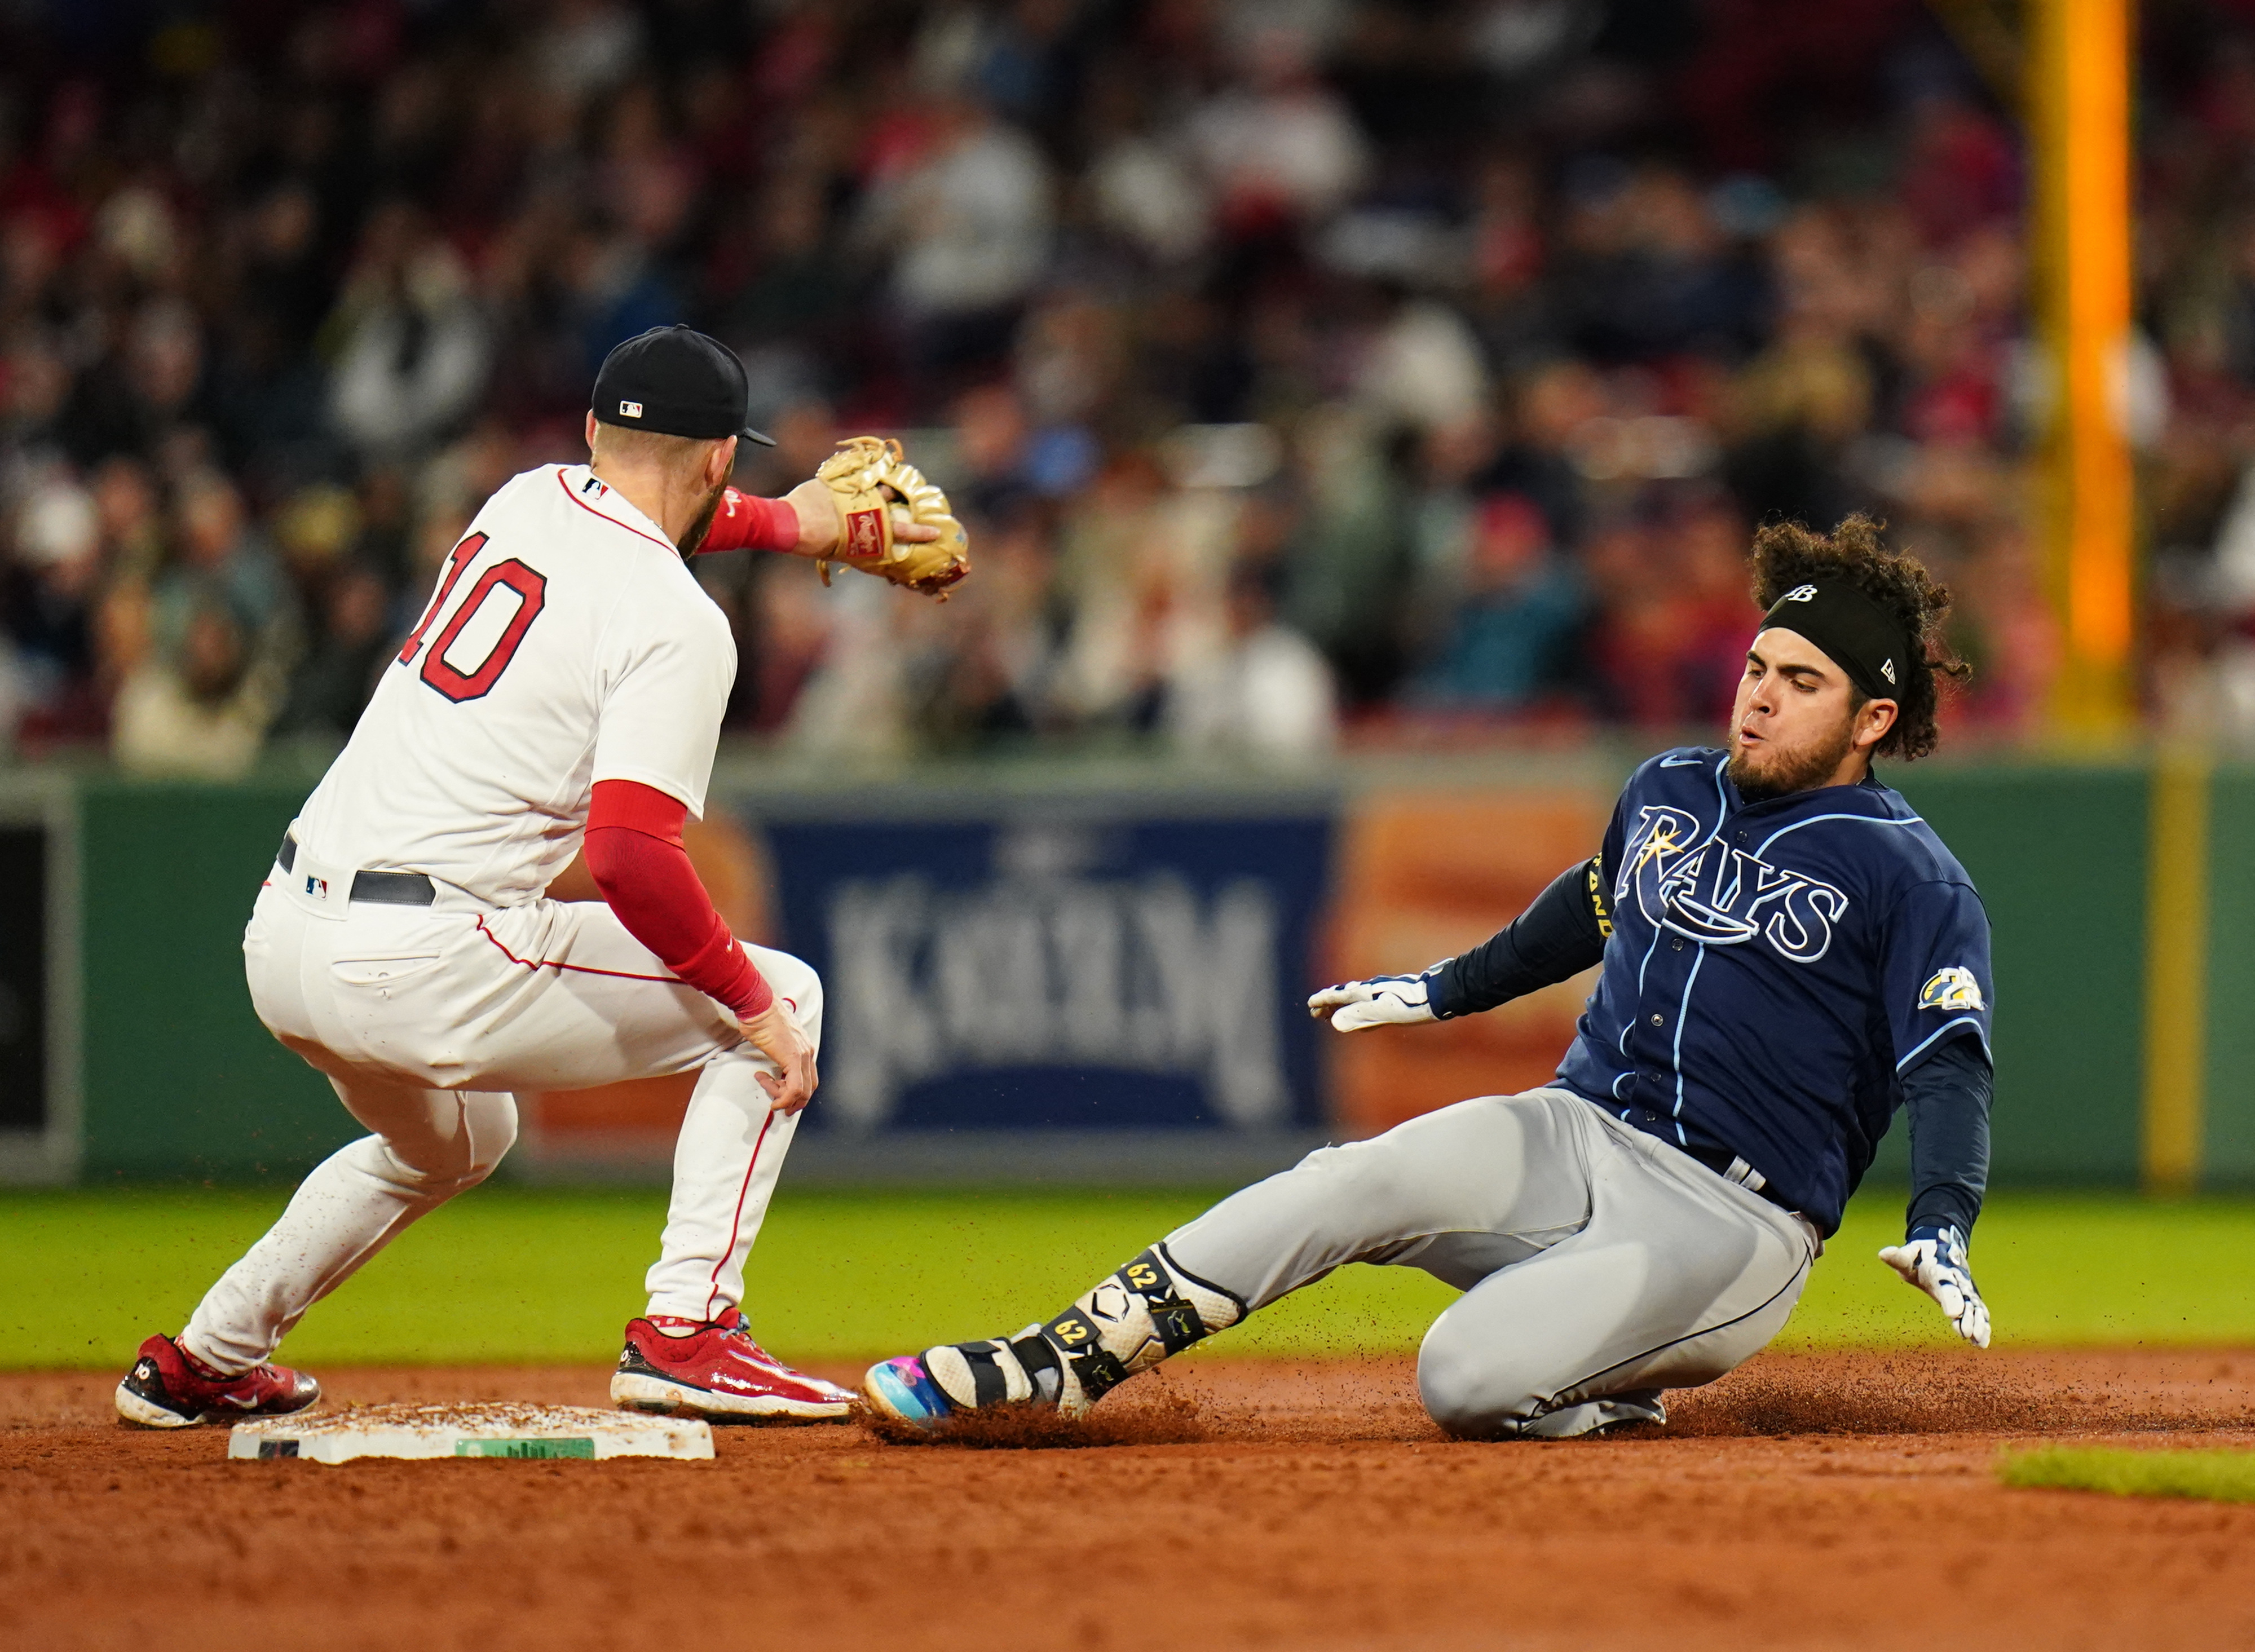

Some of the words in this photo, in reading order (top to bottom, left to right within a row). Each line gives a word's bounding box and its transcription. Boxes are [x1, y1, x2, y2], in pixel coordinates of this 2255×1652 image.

[398, 531, 548, 704] 10
[1127, 1263, 1158, 1289] 62
[1054, 1319, 1088, 1345] 62
[134, 1363, 151, 1381] 10
